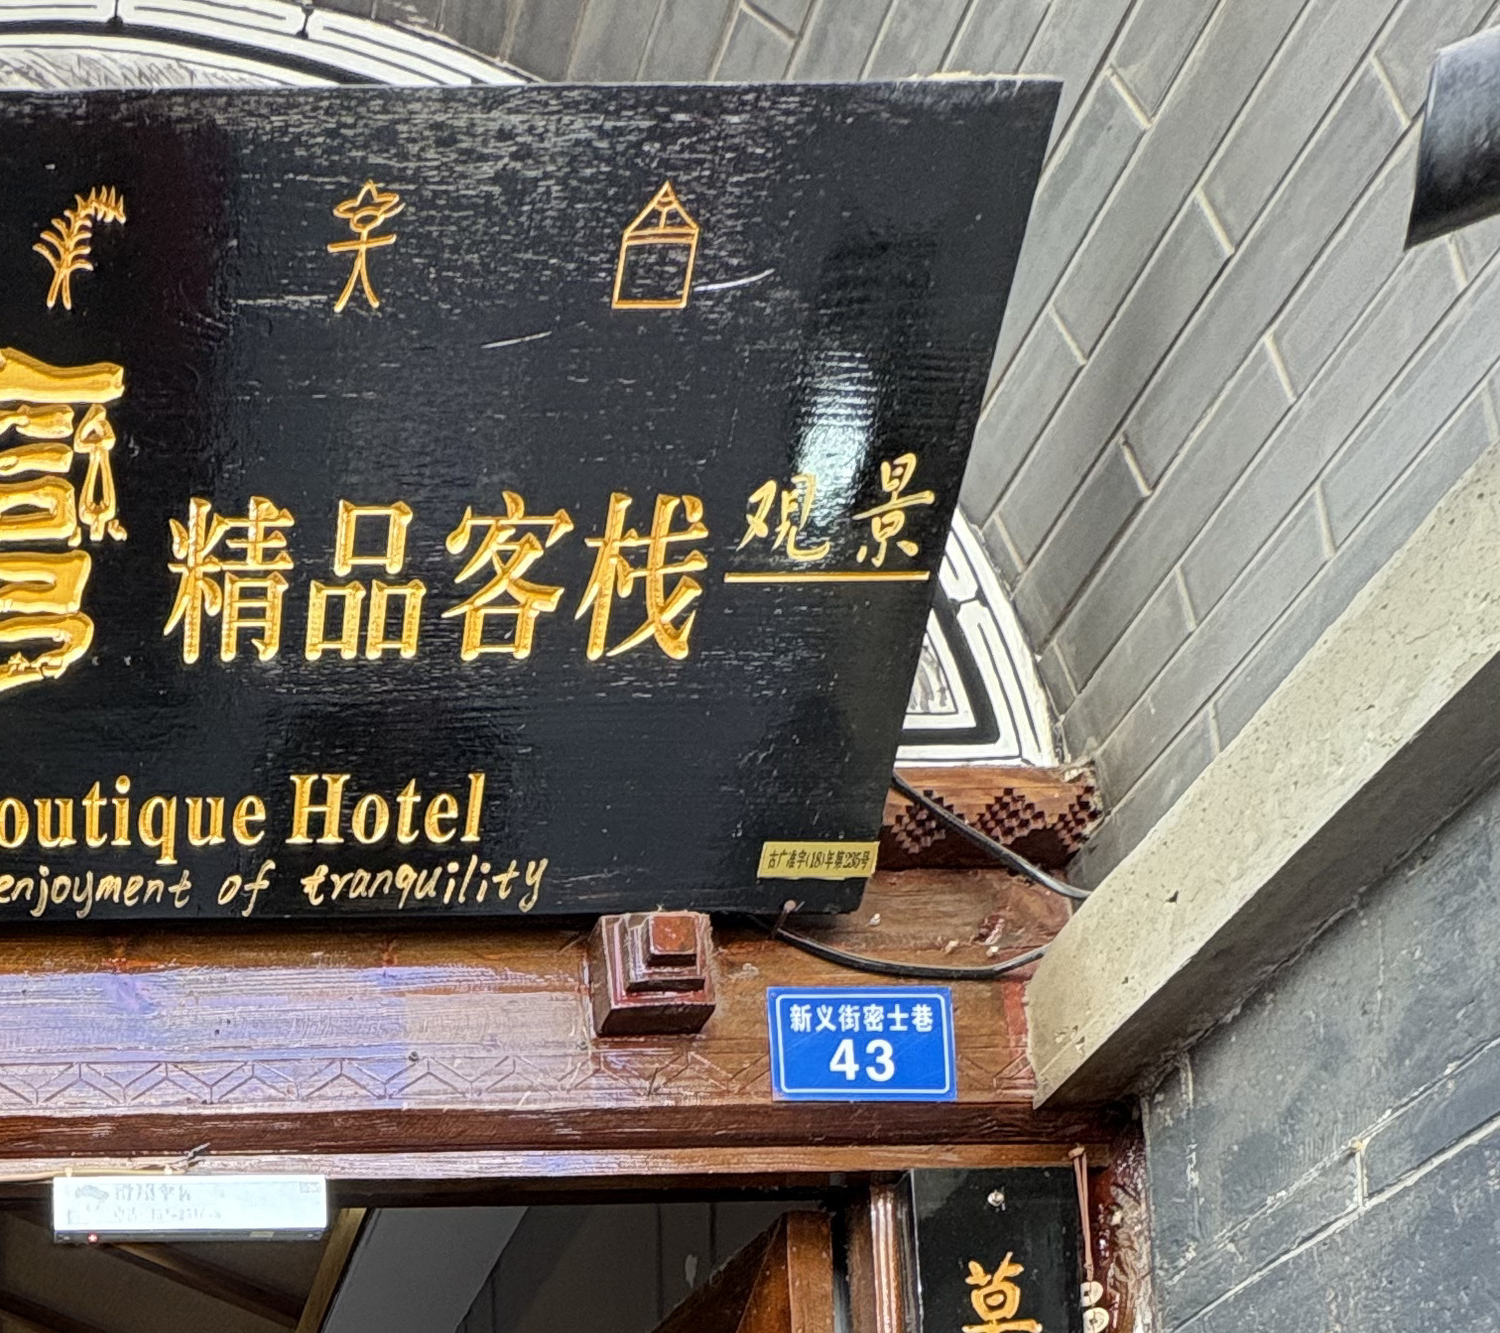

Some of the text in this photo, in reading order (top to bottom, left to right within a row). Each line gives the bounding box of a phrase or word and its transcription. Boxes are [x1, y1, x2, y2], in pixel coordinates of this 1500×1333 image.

[735, 450, 936, 568] 观景
[162, 489, 710, 666] 精品客栈
[285, 773, 486, 845] Hotel
[218, 859, 277, 917] of
[300, 854, 549, 914] tranquility
[789, 1003, 934, 1033] 新义街密士巷
[829, 1038, 896, 1082] 43
